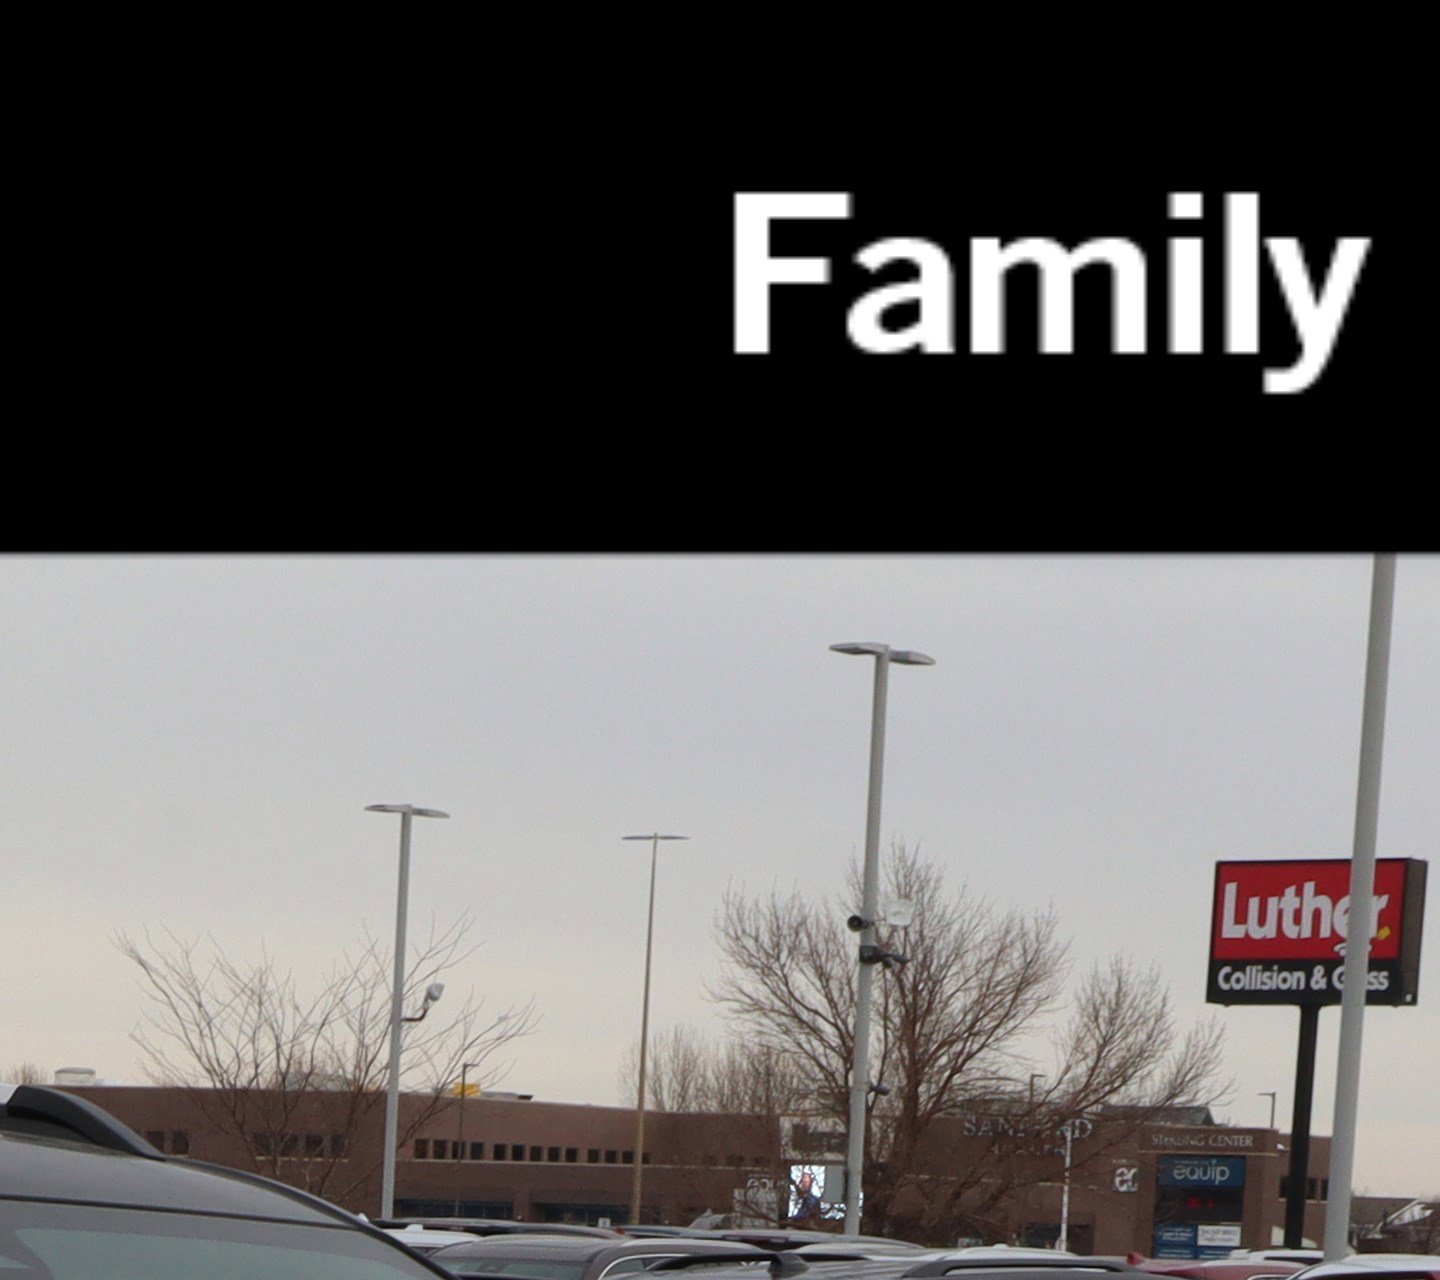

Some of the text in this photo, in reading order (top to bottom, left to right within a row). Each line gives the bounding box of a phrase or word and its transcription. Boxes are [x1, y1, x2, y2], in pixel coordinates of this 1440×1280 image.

[1217, 964, 1389, 991] Collision & Gss
[1208, 1134, 1253, 1148] CENTER
[1172, 1159, 1230, 1186] equip
